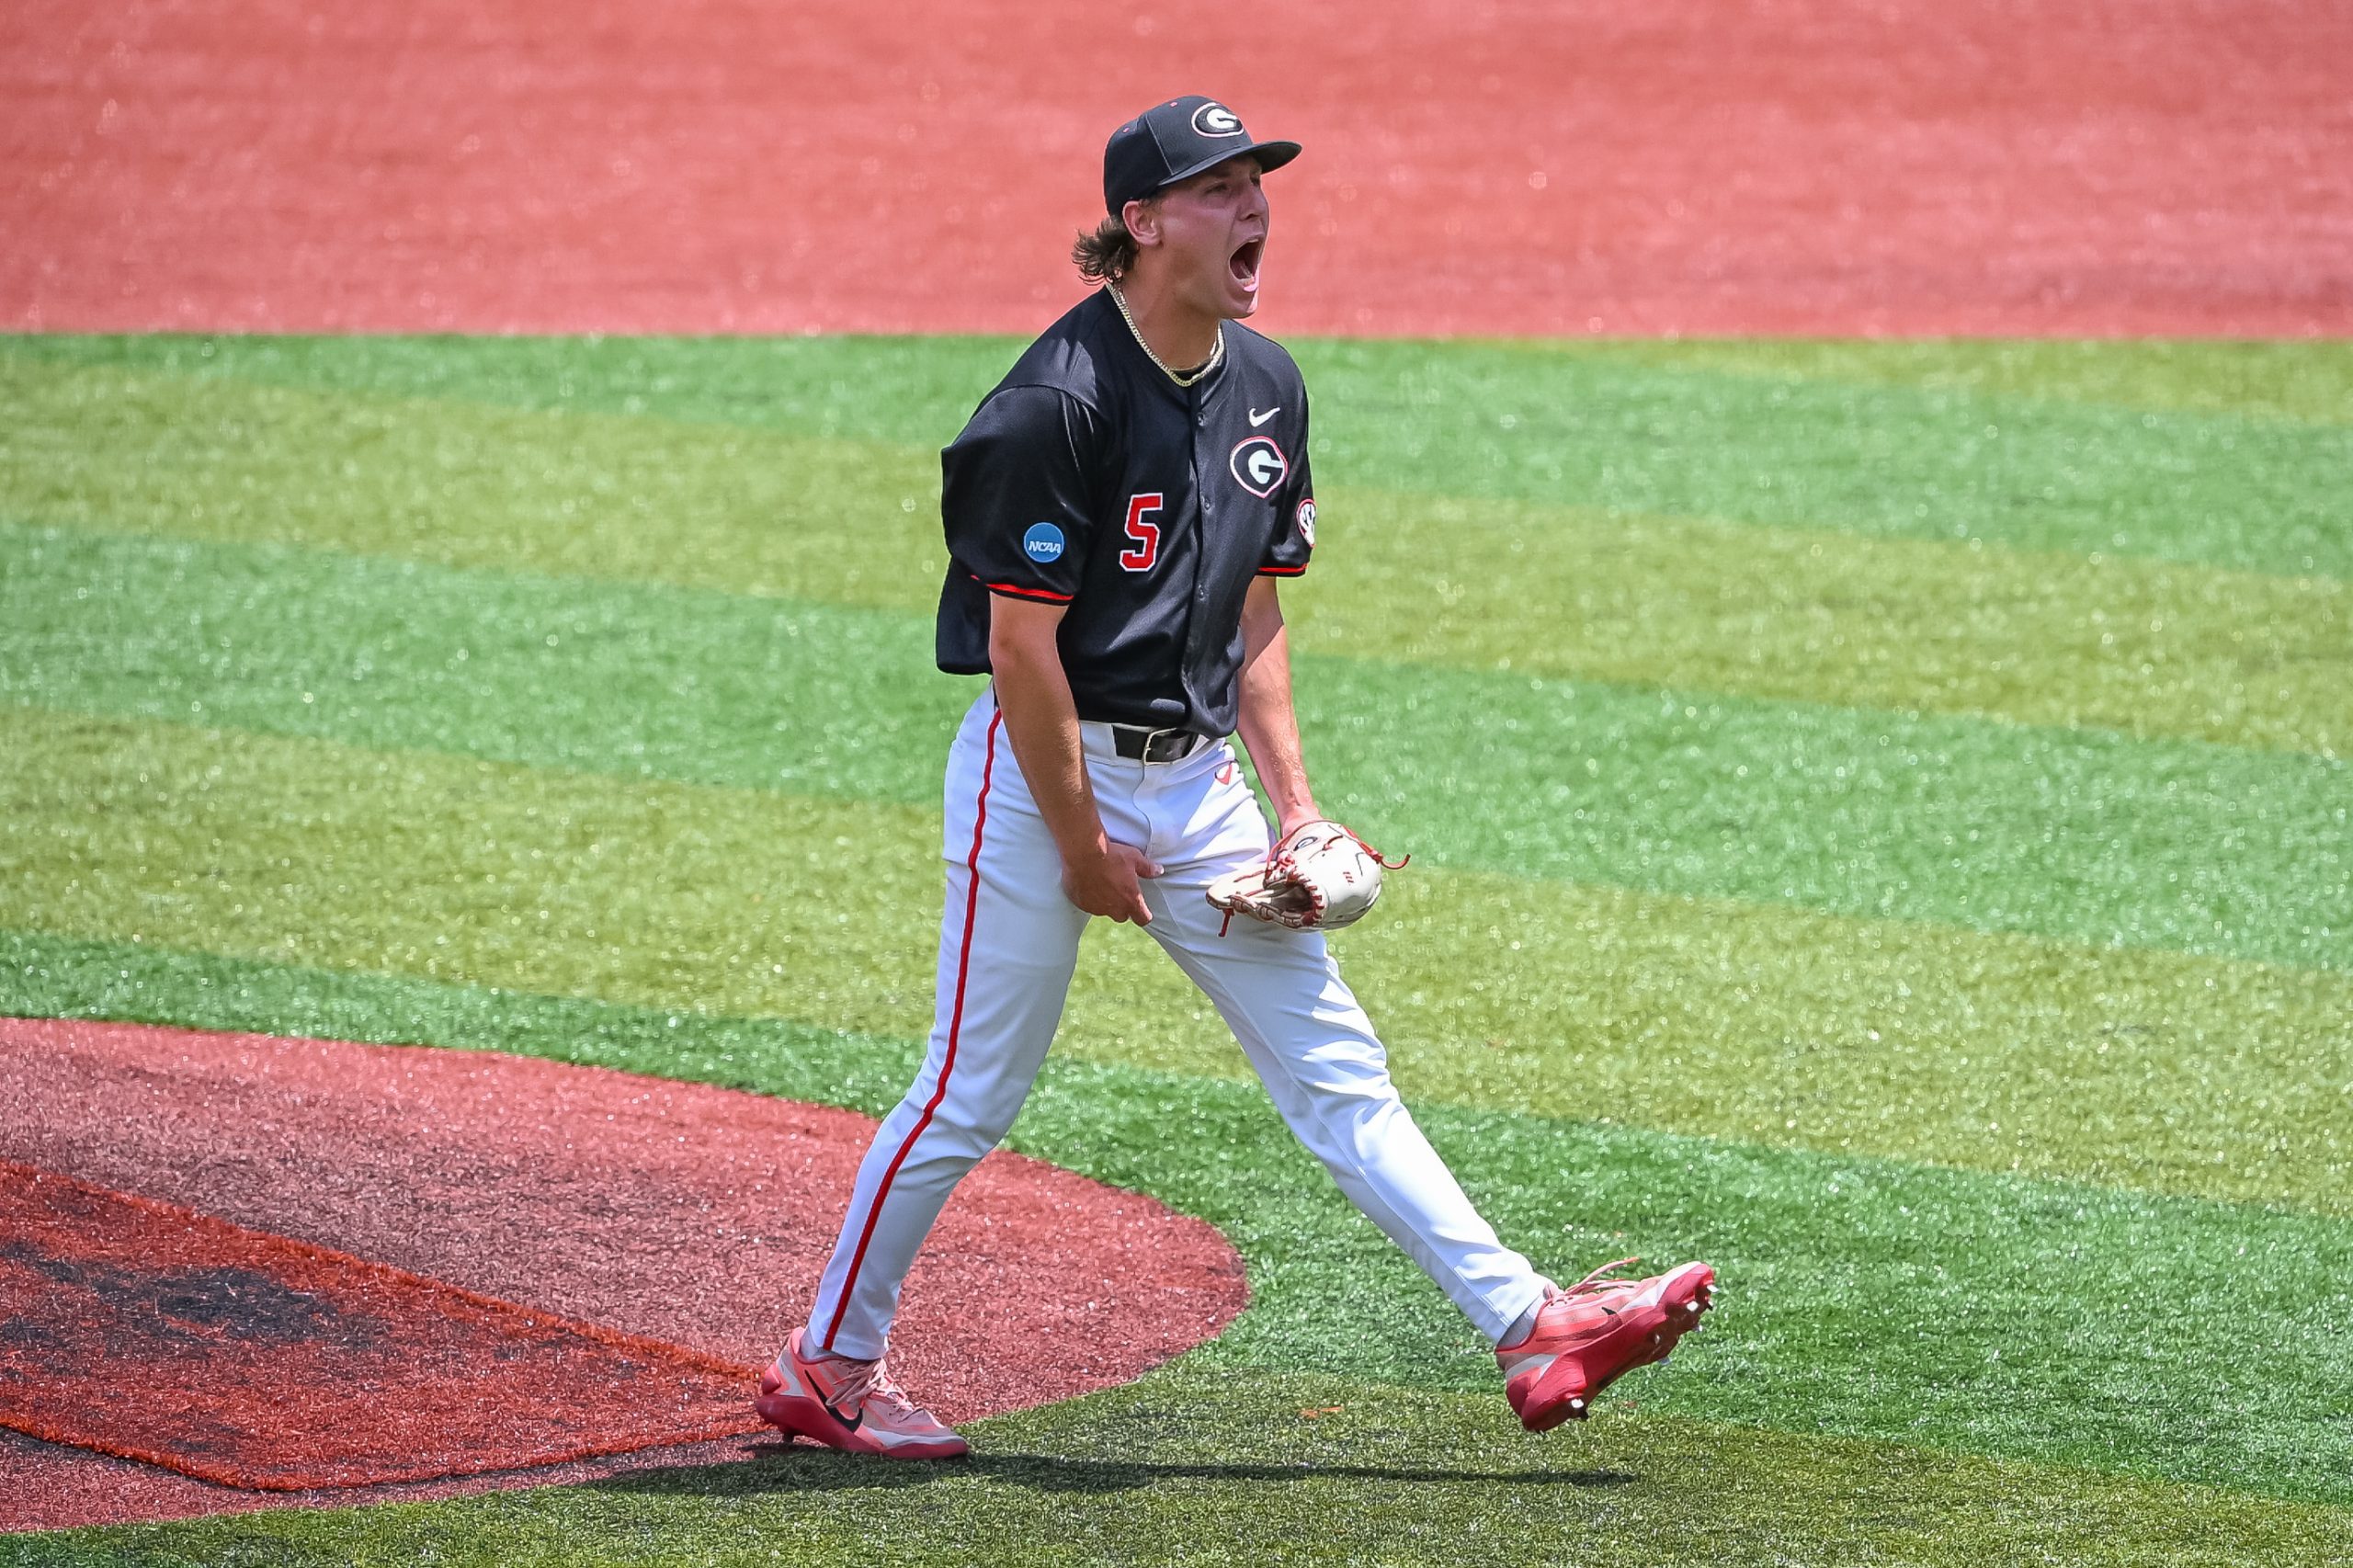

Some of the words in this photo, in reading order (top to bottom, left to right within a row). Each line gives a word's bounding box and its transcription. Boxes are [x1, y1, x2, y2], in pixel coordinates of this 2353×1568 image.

[1193, 103, 1244, 136] G
[1232, 439, 1285, 495] G
[1028, 540, 1062, 554] NCAA
[1120, 493, 1163, 572] 5
